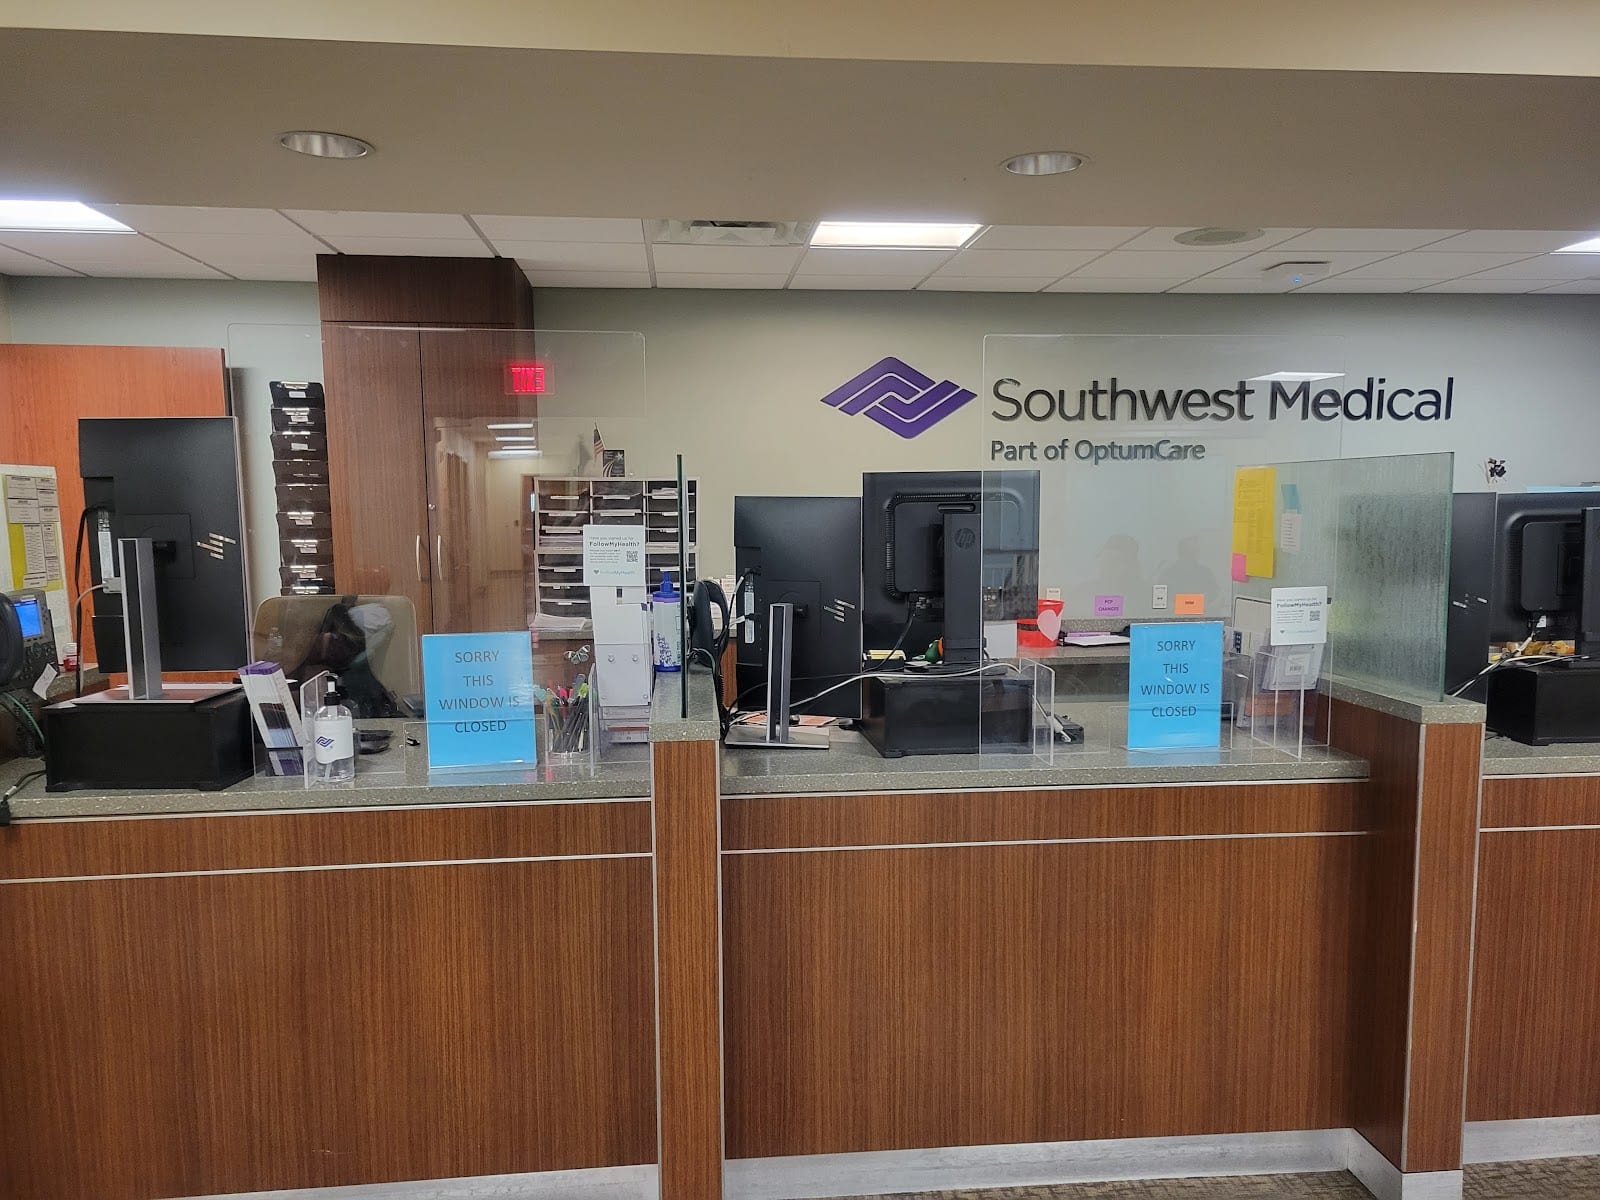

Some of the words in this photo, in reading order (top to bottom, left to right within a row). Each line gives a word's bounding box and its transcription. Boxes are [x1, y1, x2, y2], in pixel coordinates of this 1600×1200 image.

[991, 378, 1255, 422] Southwest
[1269, 377, 1454, 422] Medical
[991, 440, 1038, 461] Part
[1043, 439, 1068, 461] of
[1074, 439, 1207, 465] OptumCare
[1157, 639, 1197, 652] SORRY
[455, 650, 500, 664] SORRY
[1163, 663, 1189, 674] THIS
[463, 674, 494, 687] THIS
[1141, 683, 1197, 695] WINDOW
[1200, 683, 1210, 694] IS
[439, 697, 504, 710] WINDOW
[508, 695, 520, 707] IS
[1151, 706, 1197, 717] CLOSED
[455, 720, 507, 733] CLOSED
